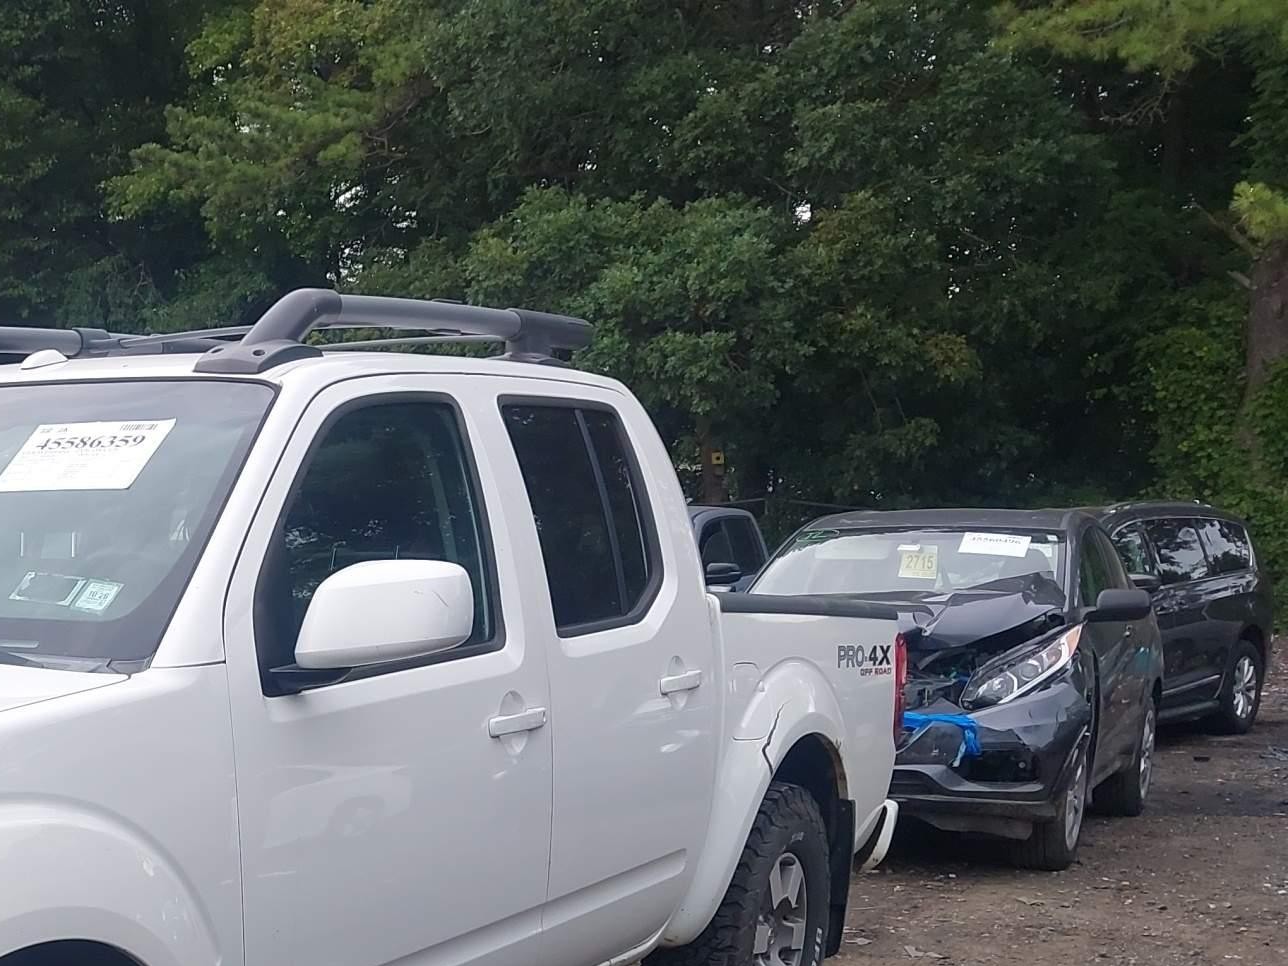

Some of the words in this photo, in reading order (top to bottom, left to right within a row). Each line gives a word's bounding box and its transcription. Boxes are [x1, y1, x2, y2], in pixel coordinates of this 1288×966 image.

[36, 435, 147, 451] 45586359
[905, 555, 934, 570] 2715
[860, 668, 873, 676] OFF
[874, 667, 892, 675] ROAD
